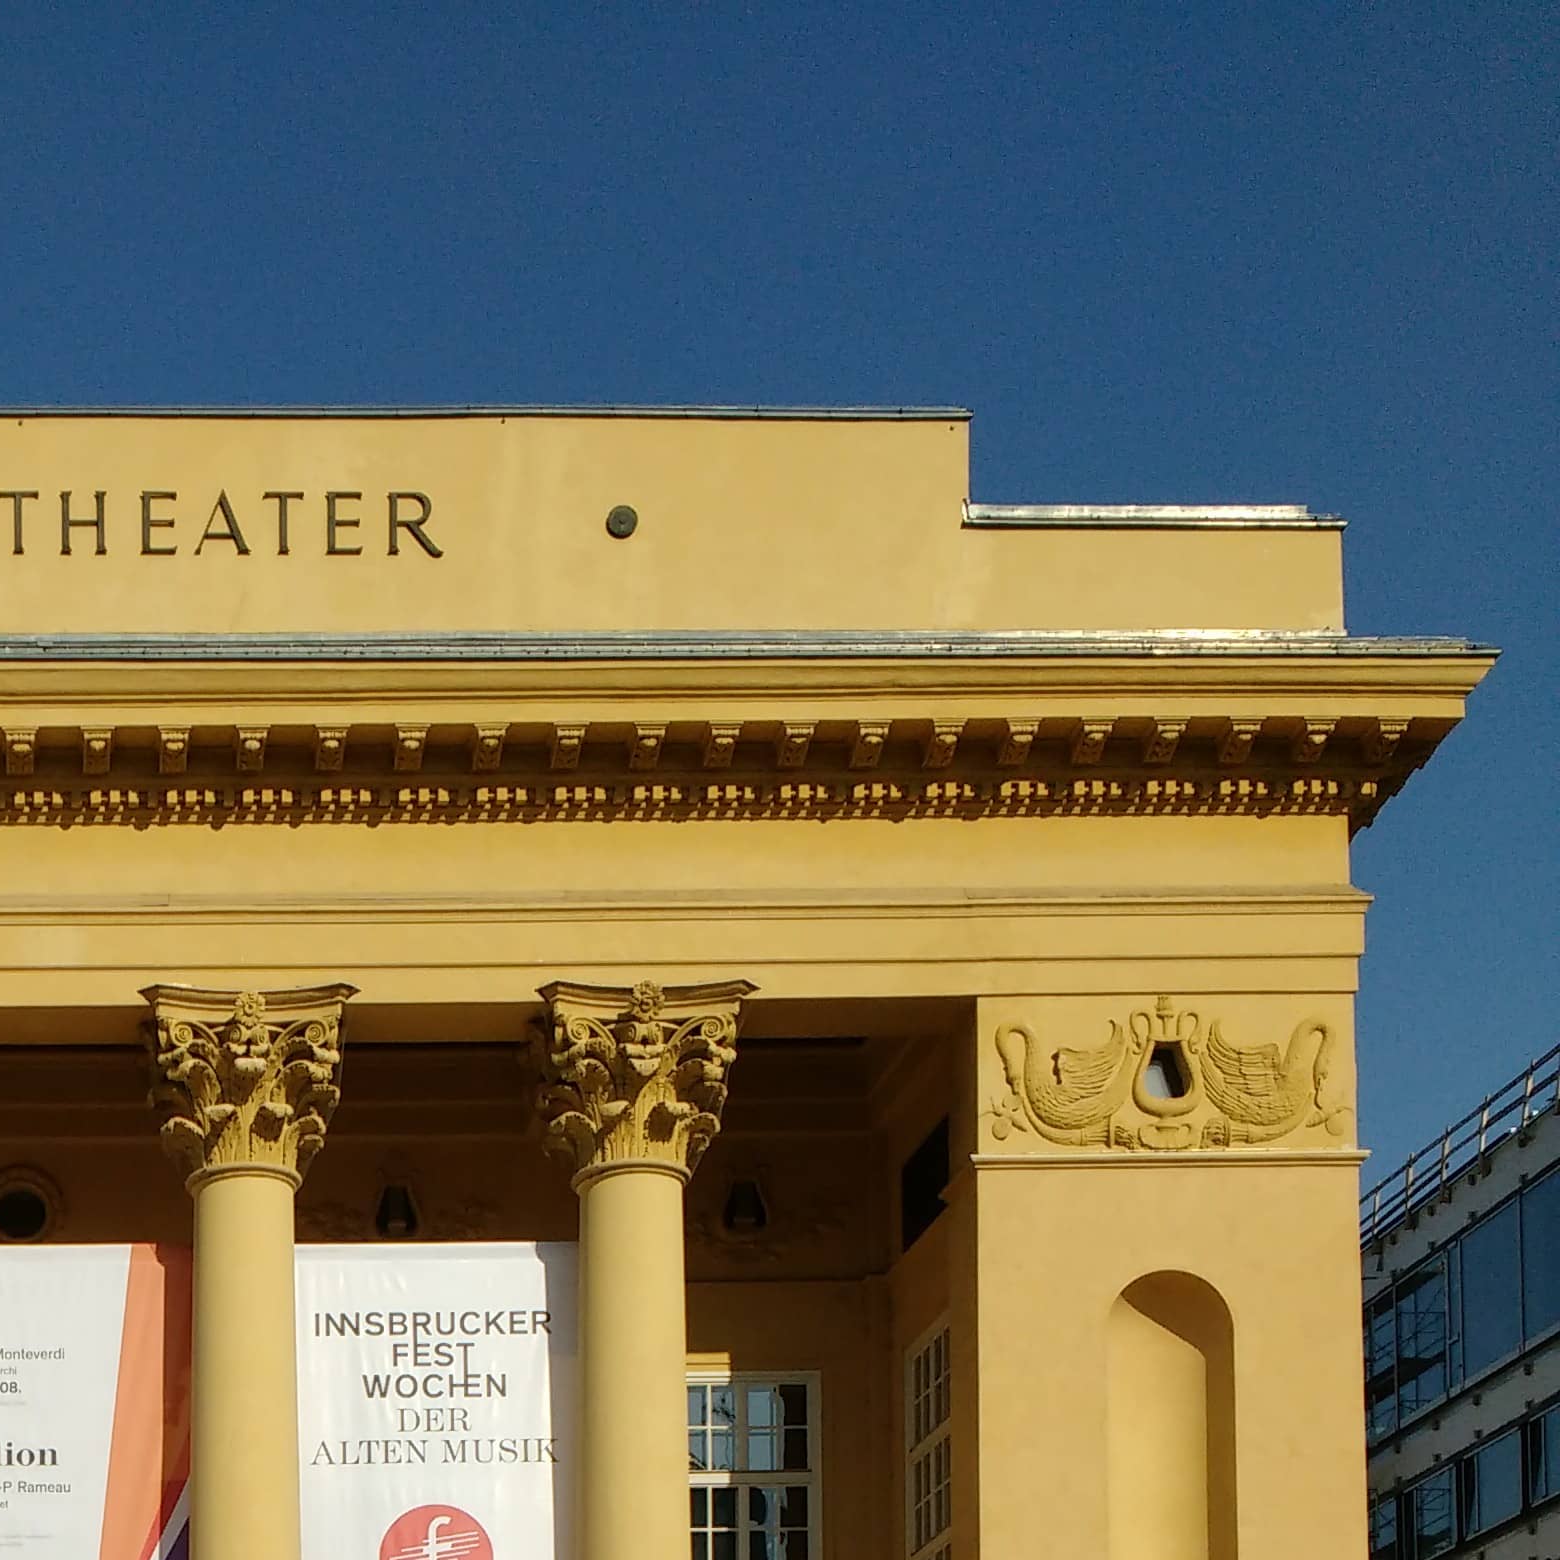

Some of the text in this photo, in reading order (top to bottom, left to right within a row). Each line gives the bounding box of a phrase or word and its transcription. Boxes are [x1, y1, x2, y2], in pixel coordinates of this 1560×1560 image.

[314, 1310, 552, 1337] INNSBRUCKER
[392, 1342, 475, 1368] FEST
[362, 1373, 507, 1399] WOCHEN
[397, 1407, 472, 1433] DER
[311, 1438, 560, 1465] ALTEN MUSIK
[17, 1480, 71, 1493] Rameau
